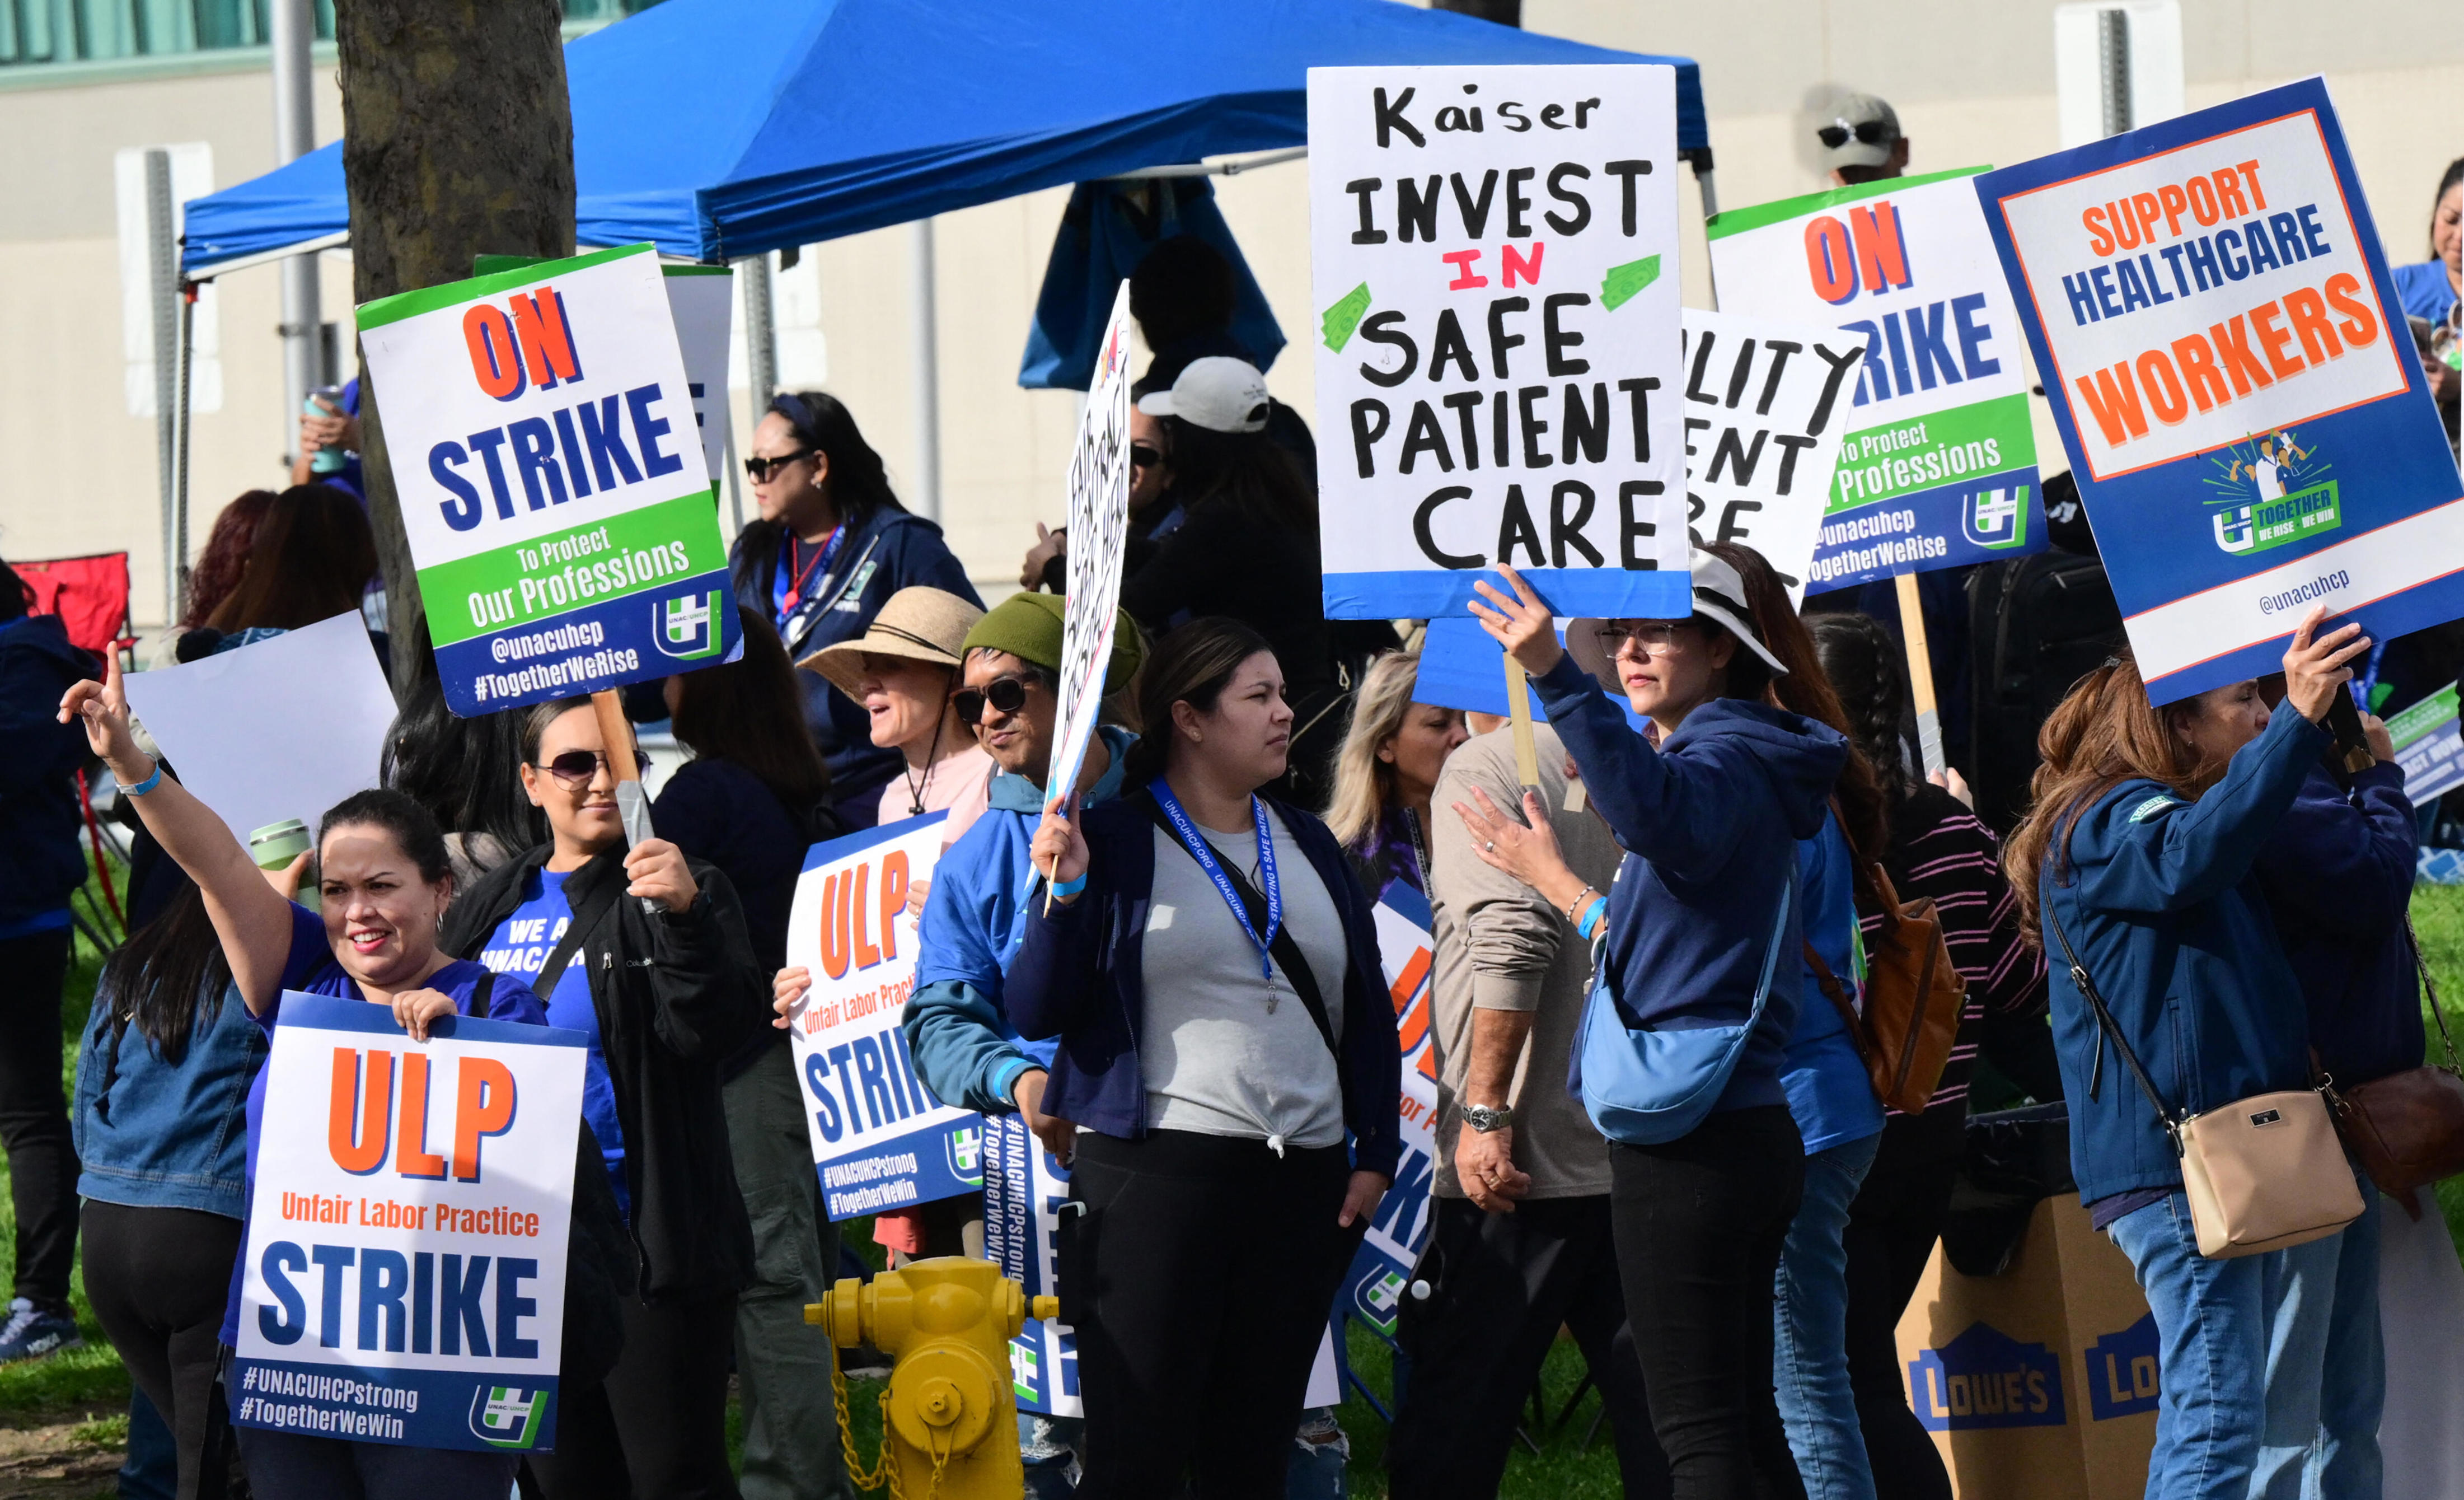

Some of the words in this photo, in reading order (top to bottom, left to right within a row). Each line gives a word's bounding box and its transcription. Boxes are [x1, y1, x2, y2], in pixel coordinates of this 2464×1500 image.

[1373, 84, 1600, 148] Kaiser
[1346, 160, 1652, 245] INVEST
[2082, 159, 2267, 258] SUPPORT
[1442, 242, 1544, 291] IN
[1804, 200, 1913, 305] ON
[2062, 203, 2331, 326] HEALTHCARE
[462, 286, 584, 402] ON
[1360, 293, 1591, 387] SAFE
[1838, 292, 2002, 407] RIKE
[2074, 272, 2378, 448] WORKERS
[1351, 377, 1660, 478] PATIENT
[1861, 422, 1929, 458] Protect
[428, 382, 683, 531] STRIKE
[1838, 438, 2002, 503] Professions
[1413, 480, 1665, 570] CARE
[2256, 489, 2331, 527] TOGETHER
[2259, 529, 2273, 542] WE
[2274, 521, 2294, 538] RISE
[2302, 515, 2316, 528] WE
[2317, 508, 2335, 524] WIN
[517, 548, 539, 573] To
[542, 526, 611, 569] Protect
[1806, 536, 1947, 583] ogetherWeRise
[468, 586, 517, 629] Our
[519, 540, 690, 614] Professions
[2260, 569, 2349, 615] @unacuhcp
[491, 621, 605, 664] @unacuhcp
[475, 648, 639, 701] #TogetherWeRise
[1164, 801, 1213, 868] UNACUHCP.ORG
[1262, 838, 1272, 863] SAFE
[820, 849, 909, 980] ULP
[1267, 872, 1278, 921] STAFFING
[509, 918, 547, 944] WE
[804, 1002, 840, 1035] Unfair
[843, 989, 877, 1022] Labor
[328, 1048, 518, 1184] ULP
[824, 1152, 918, 1188] #UNACUHCPstrong
[830, 1177, 917, 1214] #TogetherWeWin
[282, 1192, 353, 1225] Unfair
[359, 1198, 427, 1230] Labor
[436, 1203, 540, 1237] Practice
[258, 1241, 538, 1359] STRIKE
[243, 1367, 418, 1413] #UNACUHCPstrong
[1926, 1363, 2049, 1419] LOWE'S
[239, 1398, 404, 1439] #TogetherWeWin
